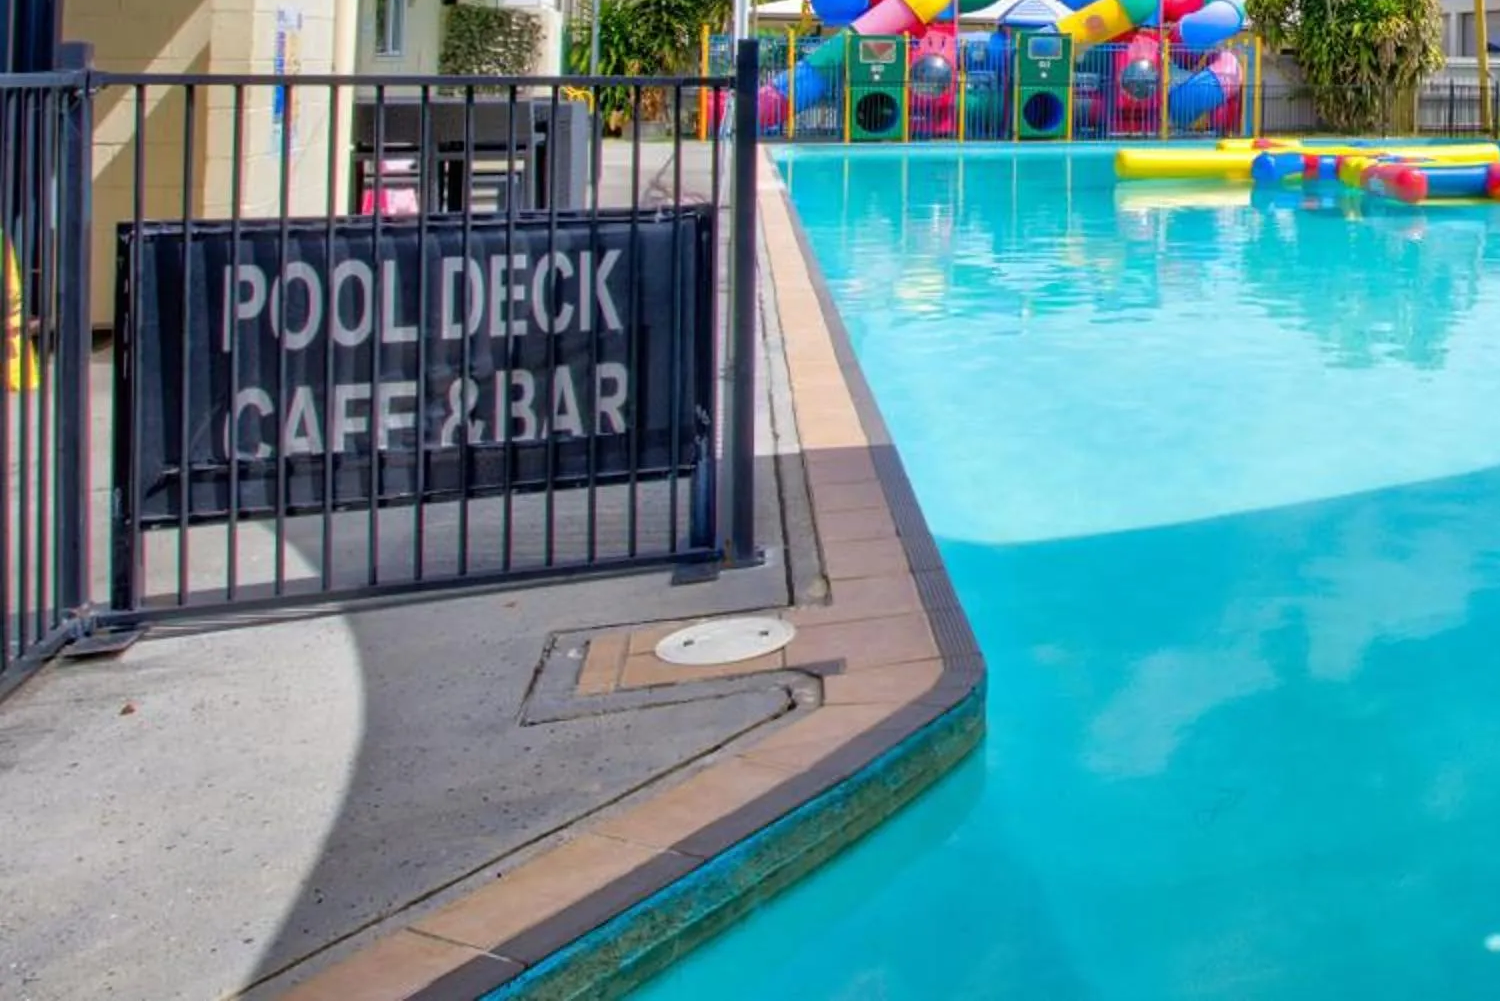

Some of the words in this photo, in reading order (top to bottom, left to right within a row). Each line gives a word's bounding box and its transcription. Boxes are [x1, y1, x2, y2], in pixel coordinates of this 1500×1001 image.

[222, 259, 419, 353] POOL
[441, 249, 624, 340] DECK
[223, 381, 418, 459] CAFE
[494, 362, 629, 442] BAR
